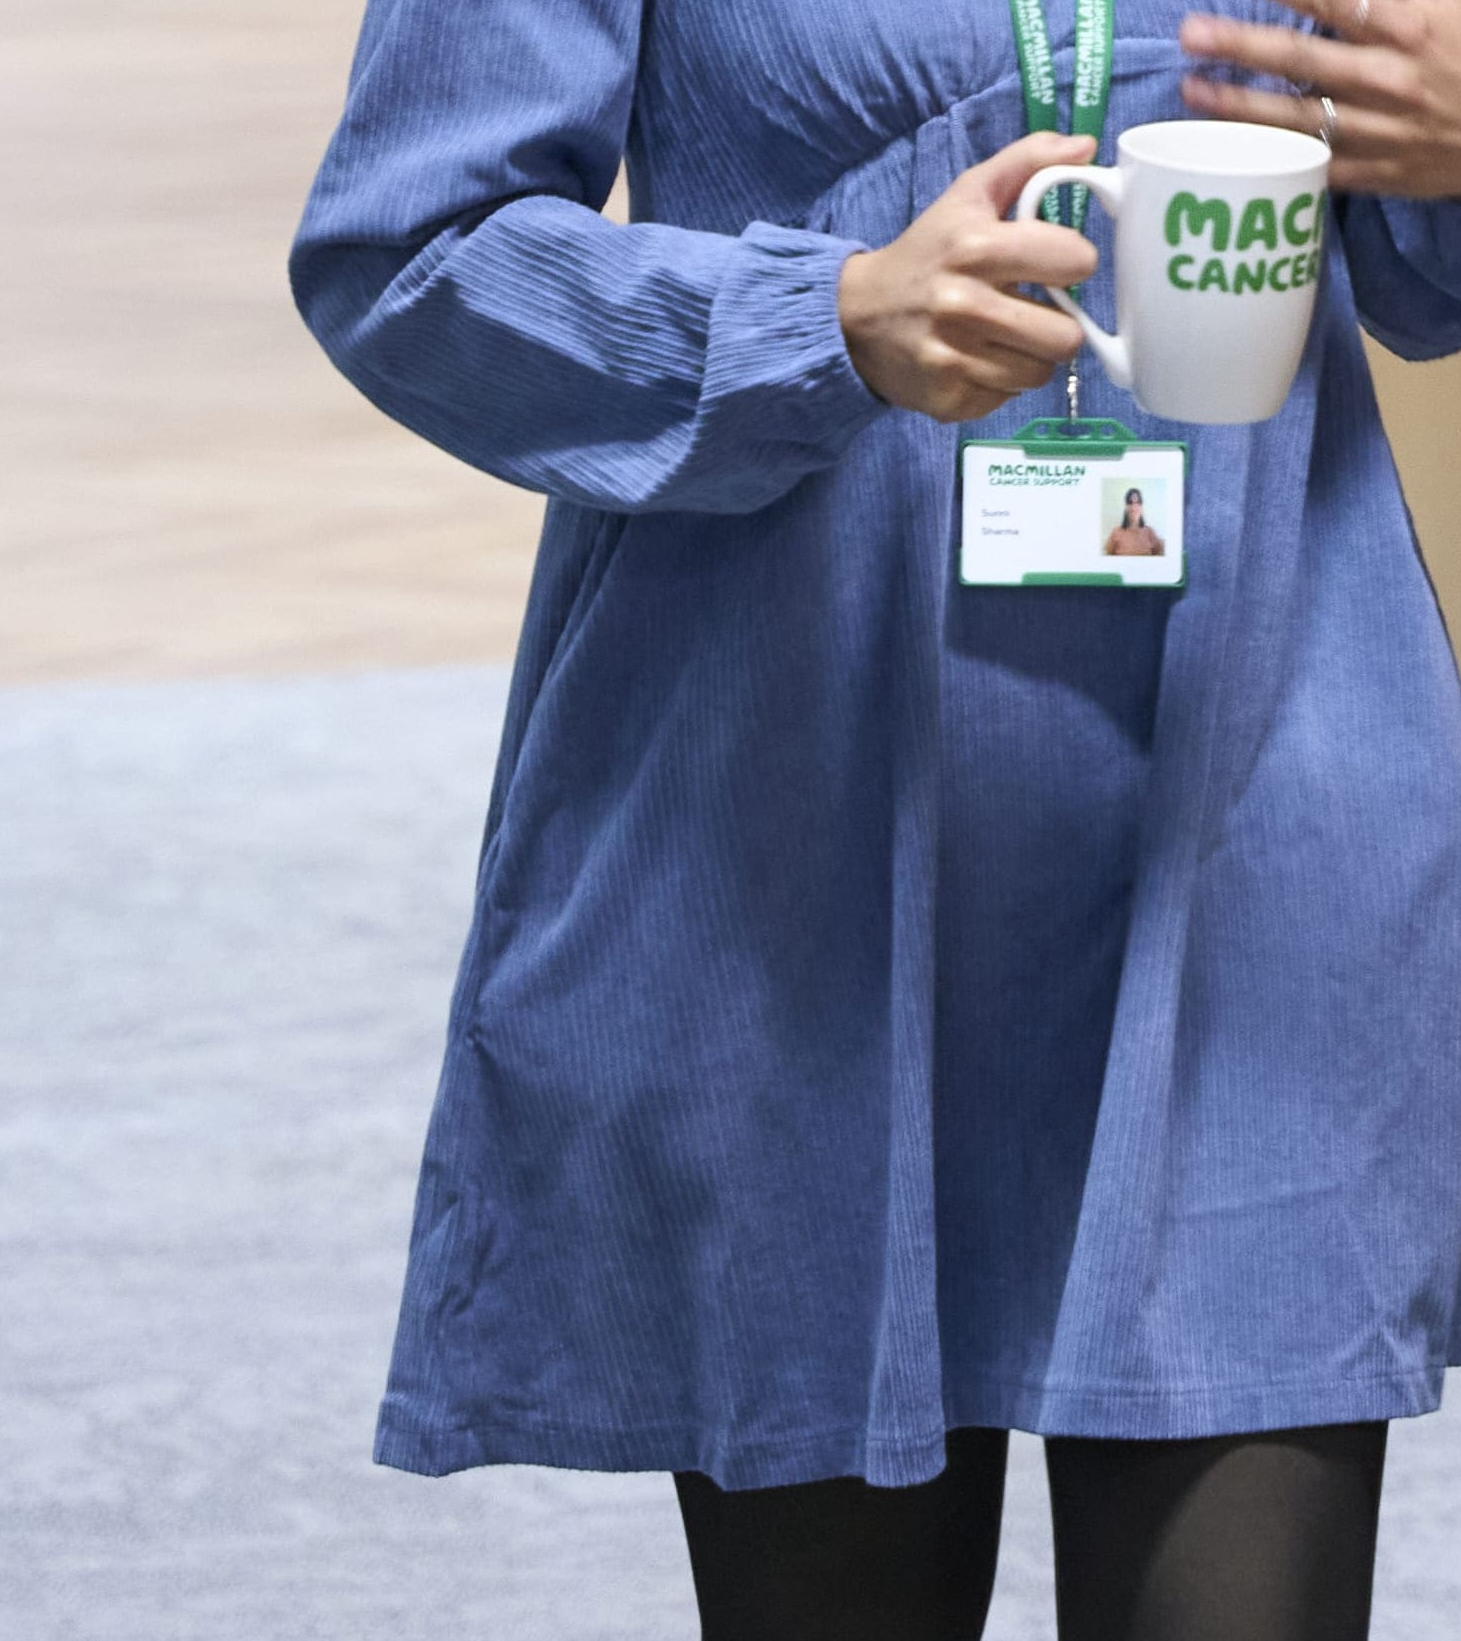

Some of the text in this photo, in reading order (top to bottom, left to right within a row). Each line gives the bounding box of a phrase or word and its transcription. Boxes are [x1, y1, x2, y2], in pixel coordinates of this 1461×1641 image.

[1164, 190, 1327, 252] MAC
[988, 464, 1085, 477] MACMILLAN
[989, 477, 1080, 486] CANCER SUPPORT
